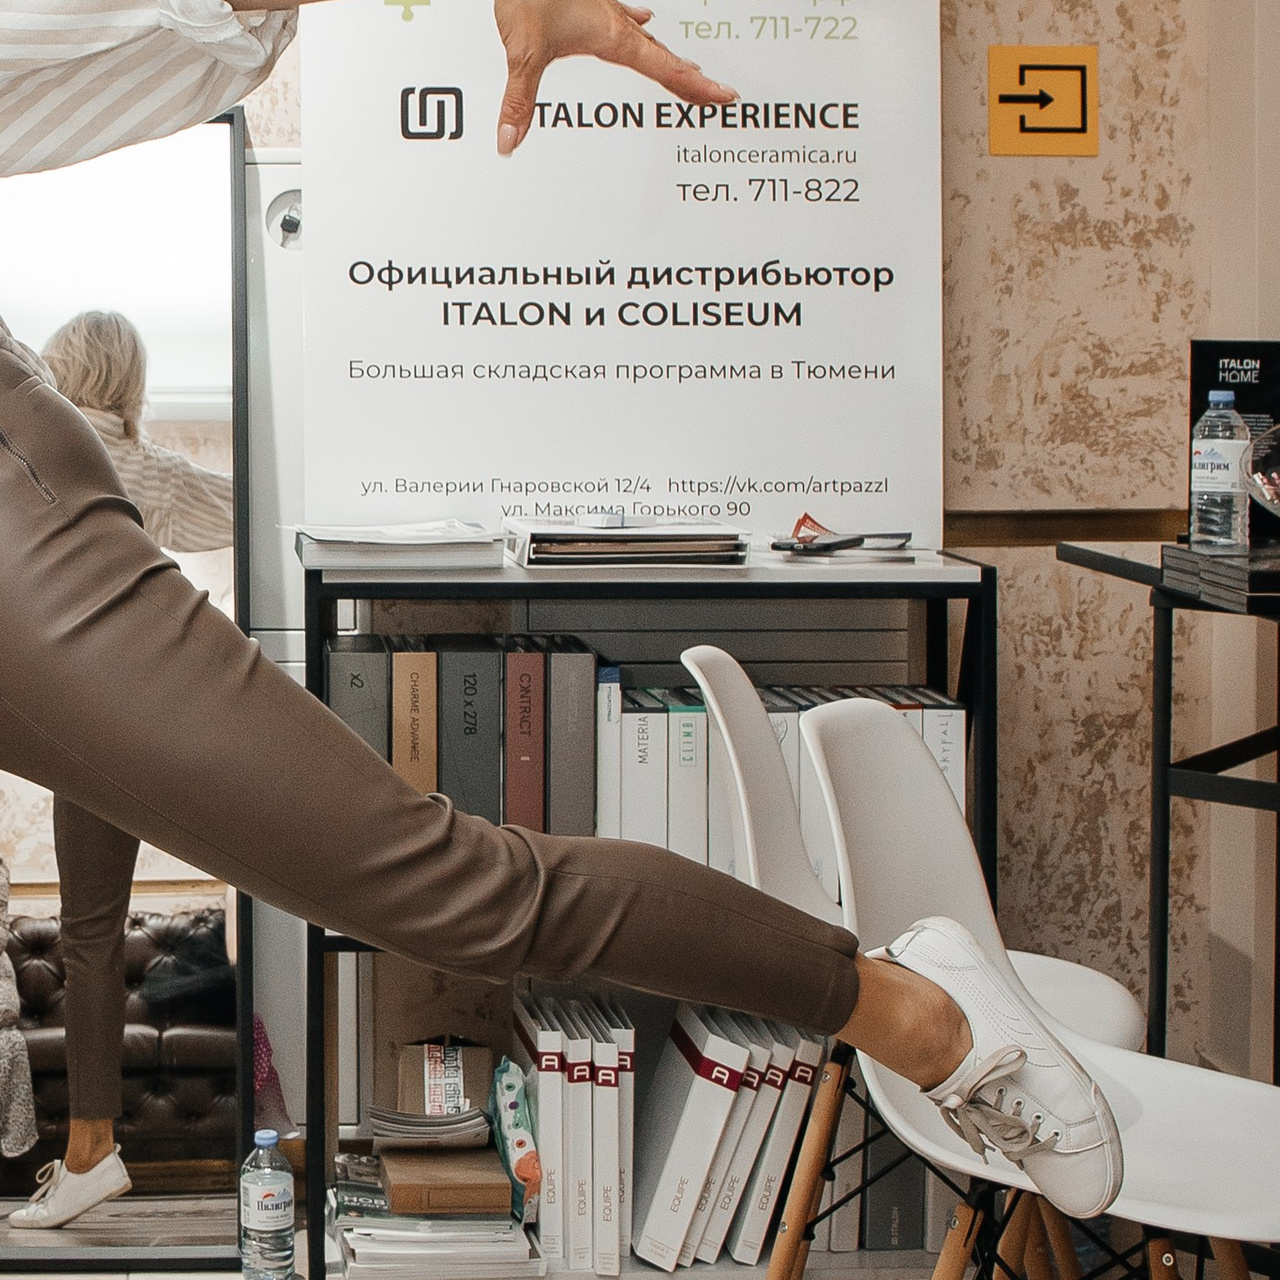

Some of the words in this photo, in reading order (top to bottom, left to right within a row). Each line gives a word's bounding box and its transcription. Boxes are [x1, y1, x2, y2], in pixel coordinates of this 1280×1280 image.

[679, 22, 741, 40] тел.
[750, 17, 859, 40] 711-722
[534, 102, 644, 129] TALON
[655, 102, 860, 130] EXPERIENCE
[676, 144, 858, 166] italonceramica.ru
[676, 184, 739, 204] тел.
[748, 179, 861, 204] 711-822
[348, 260, 616, 290] Официальный
[626, 260, 895, 291] дистрибьютор
[441, 302, 572, 328] ITALON
[584, 307, 607, 328] и
[617, 302, 803, 328] COLISEUM
[349, 360, 465, 381] Большая
[472, 365, 607, 384] складская
[615, 365, 762, 385] программа
[770, 366, 784, 381] в
[791, 361, 897, 381] Тюмени
[1219, 358, 1261, 370] ITALON
[1219, 370, 1260, 383] HOME
[360, 482, 389, 497] ул.
[395, 478, 485, 497] Валерии
[491, 476, 610, 497] Гнаровской
[614, 476, 652, 496] 12/4
[667, 475, 890, 497] https://vk.com/artpazzl
[500, 505, 529, 517] ул.
[535, 502, 626, 517] Максима
[632, 502, 723, 518] Горького
[726, 501, 752, 517] 90
[410, 671, 420, 714] CHARME
[463, 672, 478, 696] 120
[463, 710, 478, 736] 278
[637, 715, 650, 765] MATERIA
[546, 1168, 556, 1205] EQUIPE
[577, 1179, 587, 1216] EQUIPE
[670, 1176, 690, 1214] EQUIPE
[696, 1174, 717, 1212] EQUIPE
[720, 1174, 740, 1211] EQUIPE
[757, 1174, 777, 1211] EQUIPE
[602, 1184, 612, 1222] EQUIPE
